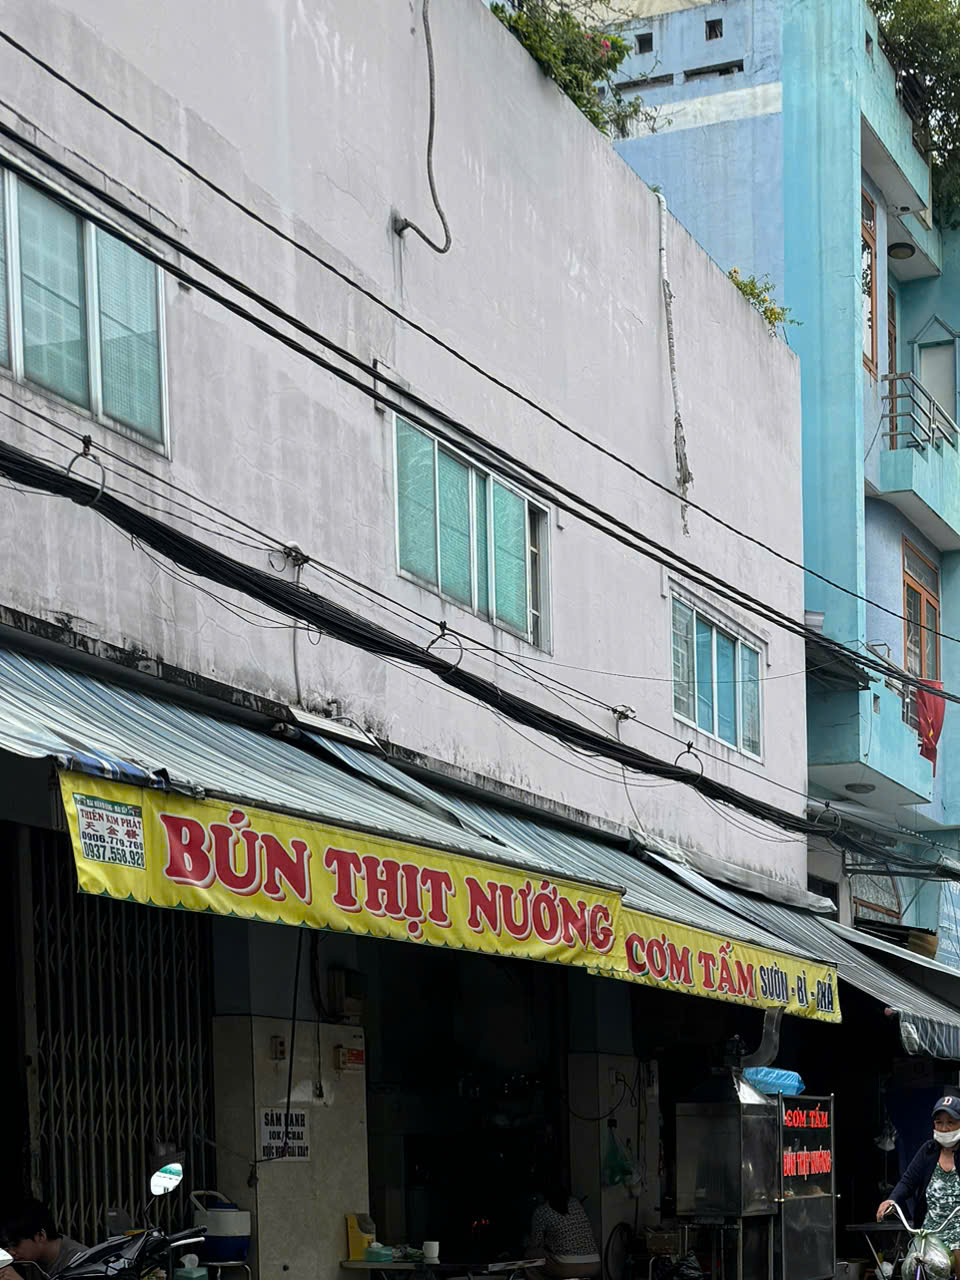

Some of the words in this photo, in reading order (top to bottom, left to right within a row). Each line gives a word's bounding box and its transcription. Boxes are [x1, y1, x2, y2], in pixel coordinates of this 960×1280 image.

[80, 809, 104, 822] THIÊN
[105, 814, 119, 826] KIM
[120, 817, 142, 830] PHÁT
[160, 809, 313, 906] BÚN
[324, 847, 456, 940] THỊT
[465, 877, 616, 954] NƯỚNG
[625, 932, 694, 988] CƠM
[697, 941, 757, 1000] TẤM
[760, 961, 788, 1004] SƯỜN
[797, 970, 809, 1008] BÌ
[264, 1109, 281, 1127] SÂM
